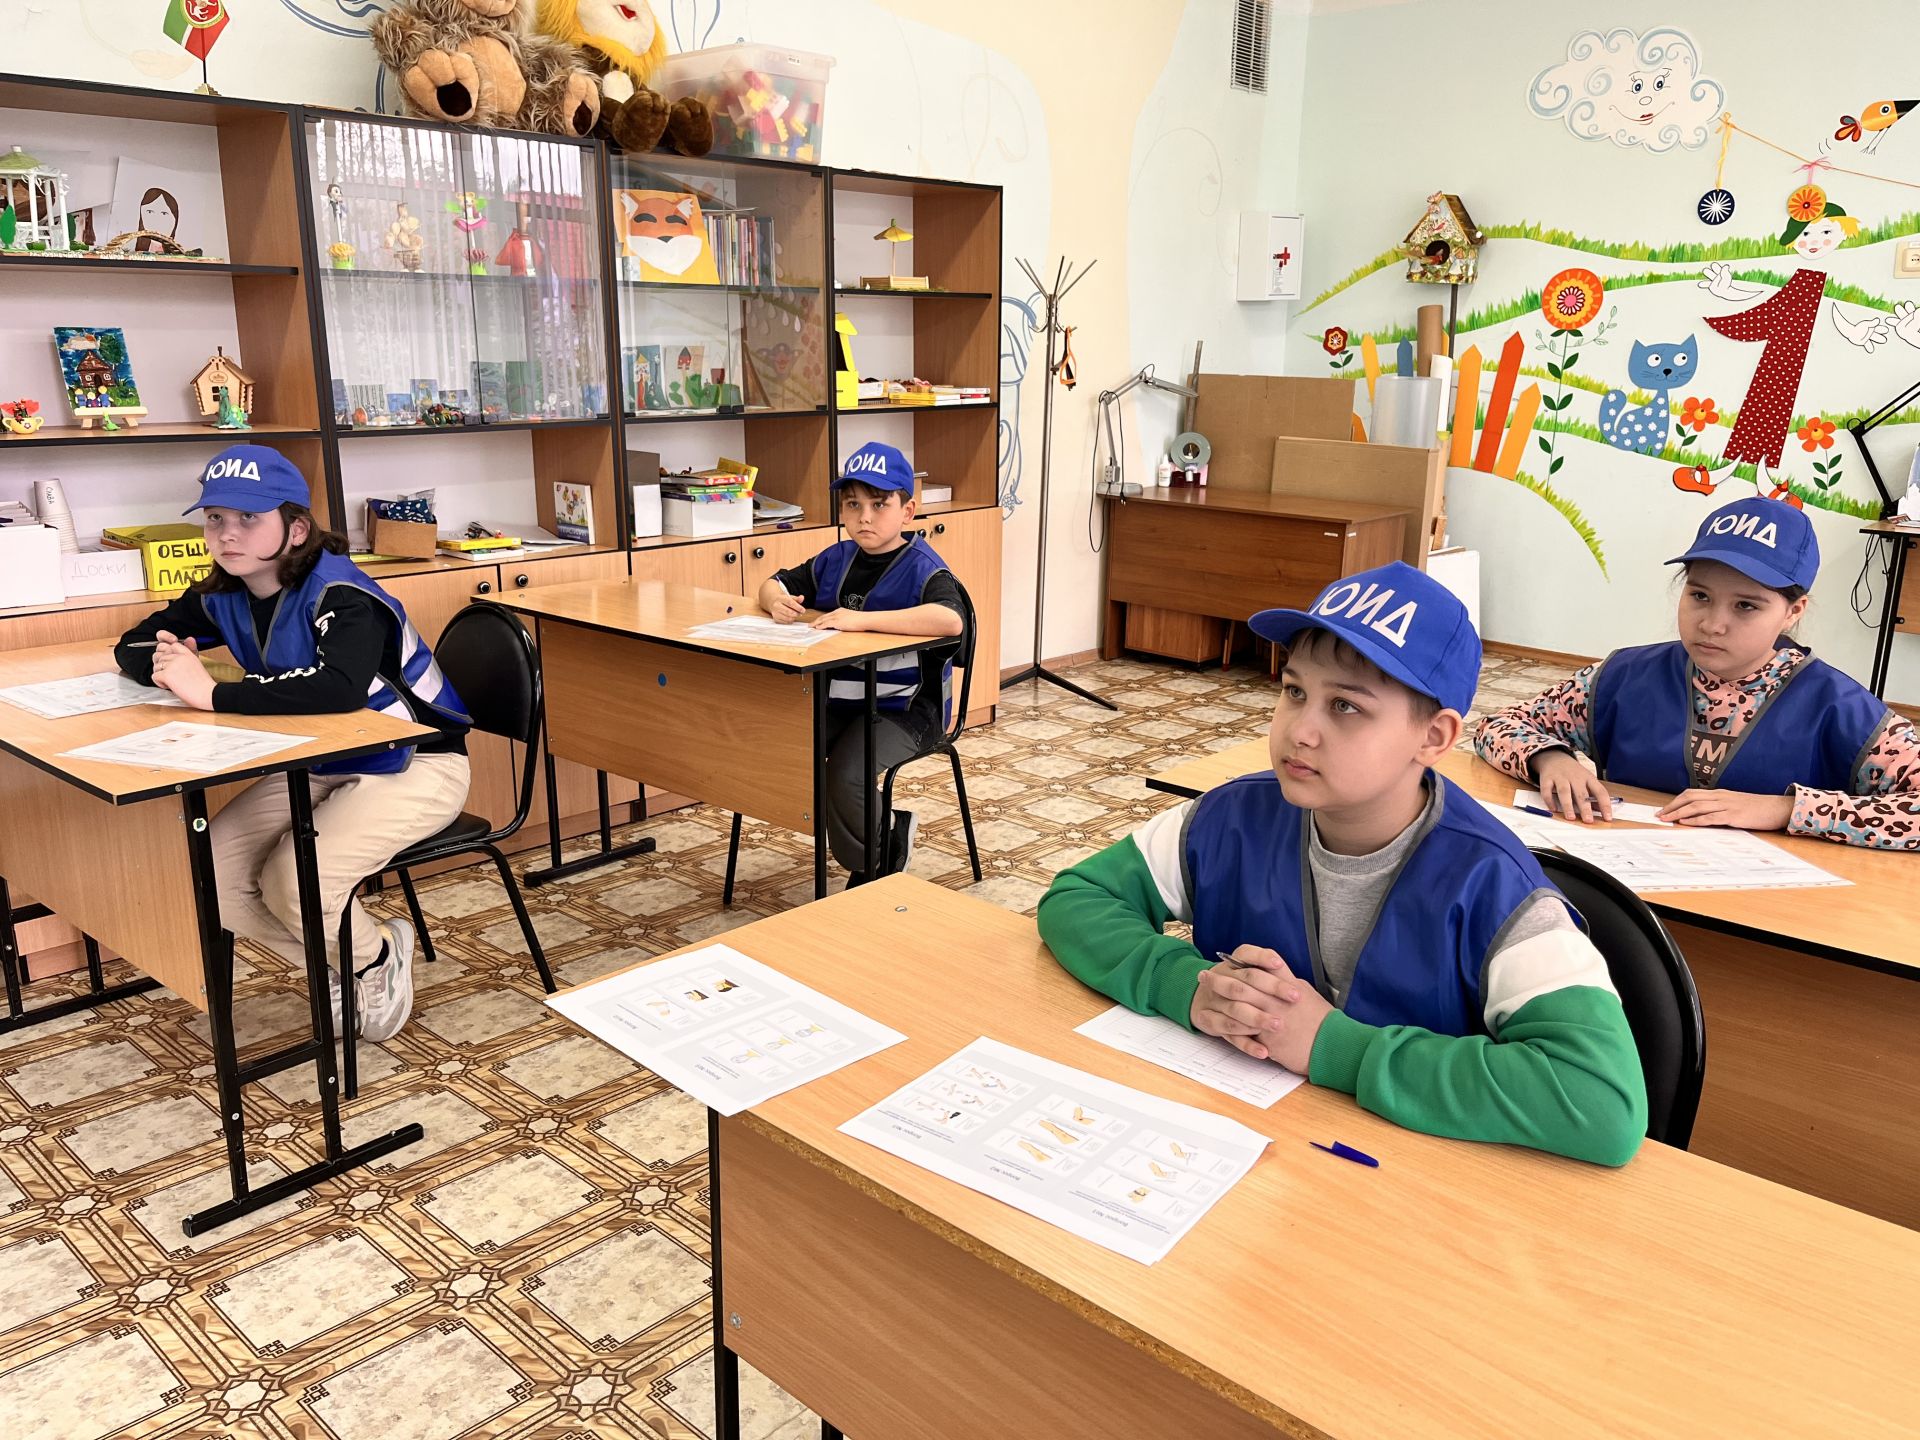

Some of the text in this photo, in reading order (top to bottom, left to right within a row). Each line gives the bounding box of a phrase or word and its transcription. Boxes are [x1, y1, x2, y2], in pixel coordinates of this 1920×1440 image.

[206, 459, 261, 481] ЮИД
[847, 453, 887, 475] ЮИД
[1705, 513, 1778, 549] ЮИД
[1309, 582, 1418, 649] ЮИД
